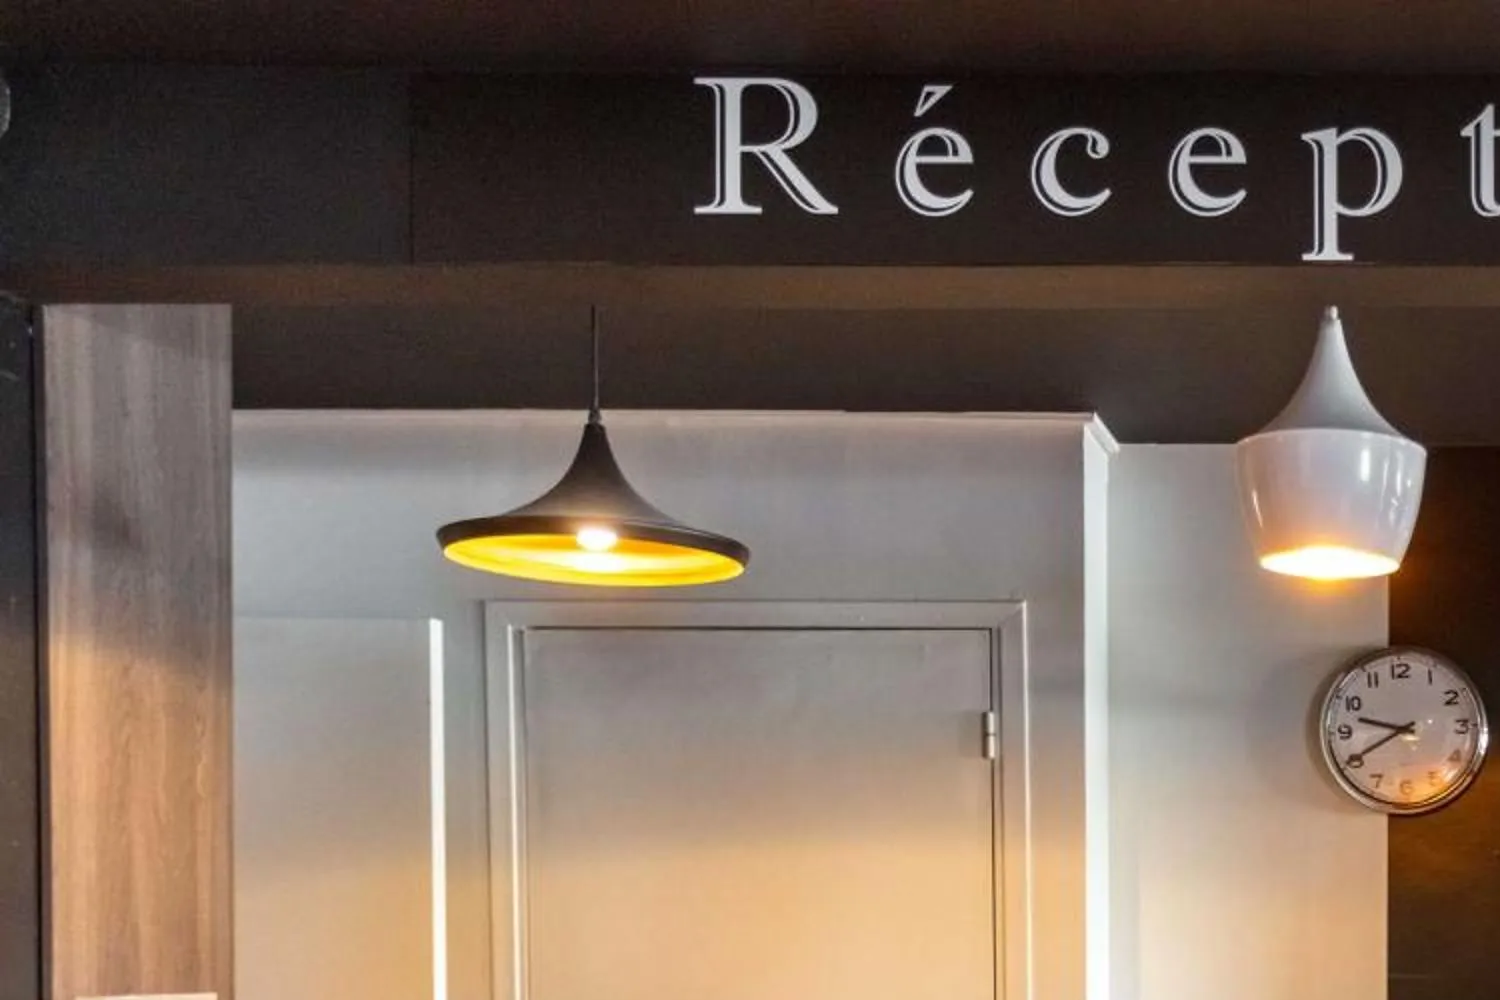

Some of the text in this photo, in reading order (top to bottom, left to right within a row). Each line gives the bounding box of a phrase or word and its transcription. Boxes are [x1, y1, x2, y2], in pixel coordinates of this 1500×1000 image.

[1391, 663, 1410, 679] 12
[1367, 671, 1379, 688] 11
[1345, 696, 1361, 711] 10
[1444, 689, 1459, 705] 2
[1338, 724, 1352, 739] 9
[1456, 719, 1469, 734] 3
[1447, 750, 1461, 763] 4
[1370, 774, 1383, 788] 7
[1401, 779, 1413, 794] 6
